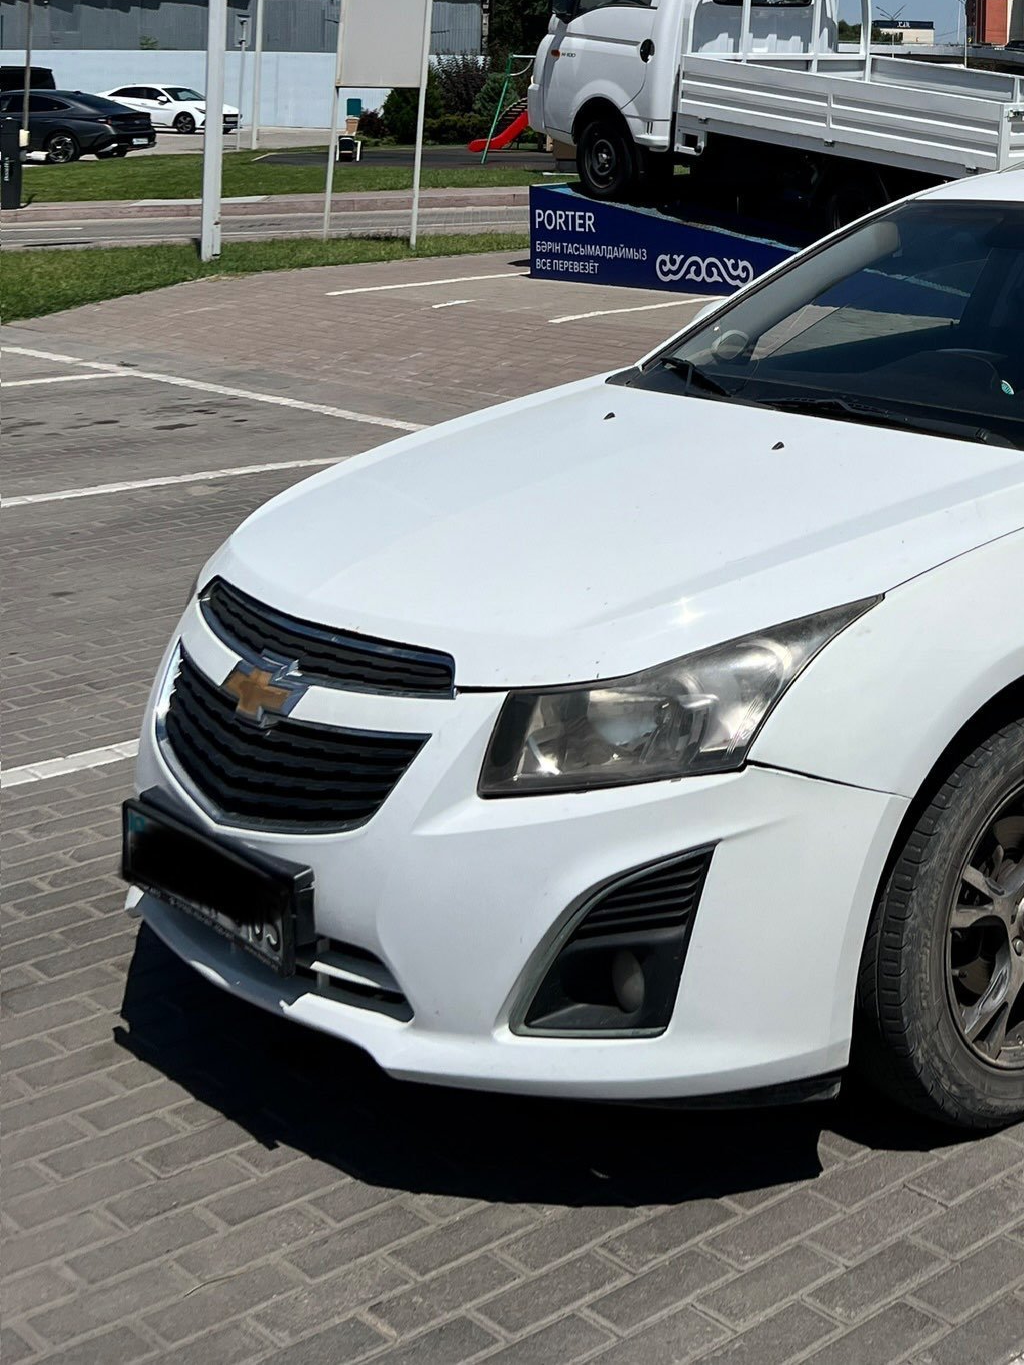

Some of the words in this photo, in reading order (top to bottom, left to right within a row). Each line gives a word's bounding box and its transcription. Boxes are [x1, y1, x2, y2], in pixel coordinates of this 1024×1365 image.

[535, 209, 596, 233] PORTER
[536, 240, 561, 253] БӘРІН
[562, 242, 648, 261] ТАСЫМАЛДАЙМЫЗ
[536, 258, 551, 270] ВСЕ
[553, 259, 599, 274] ПЕРЕВЕЗЁТ
